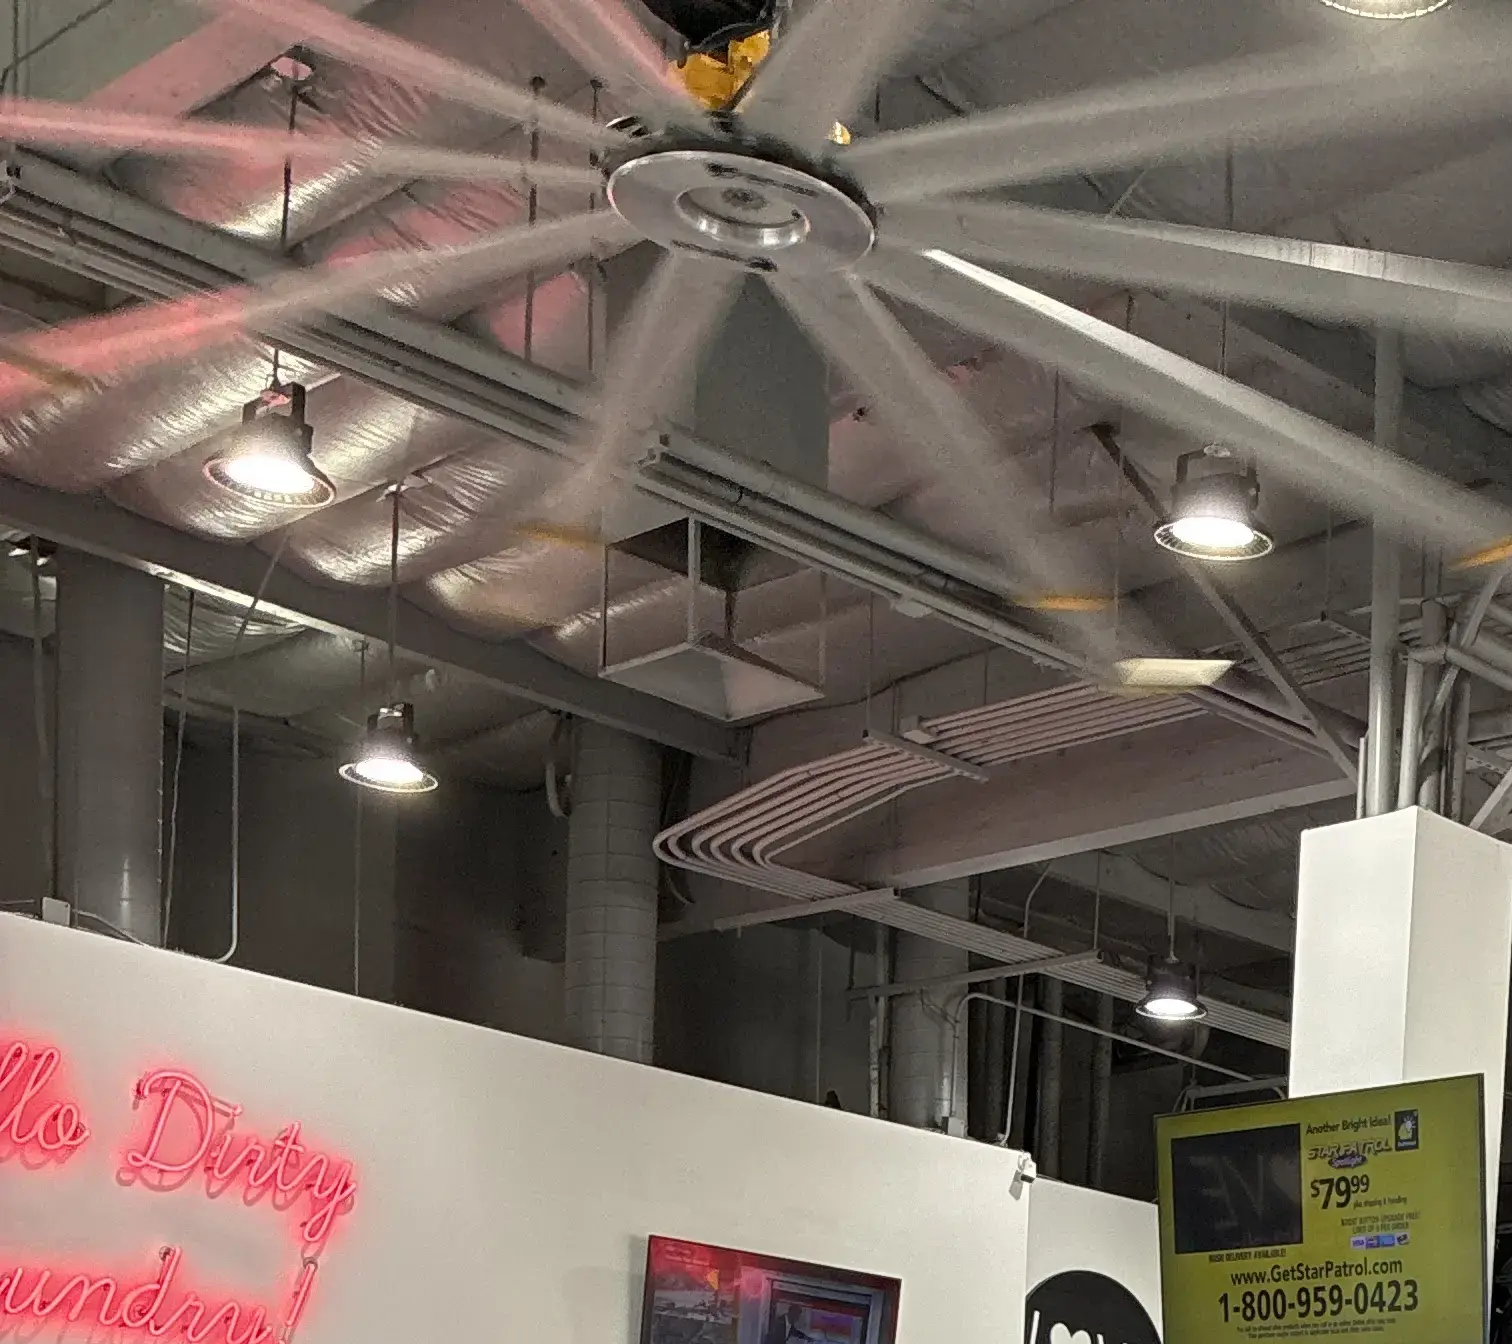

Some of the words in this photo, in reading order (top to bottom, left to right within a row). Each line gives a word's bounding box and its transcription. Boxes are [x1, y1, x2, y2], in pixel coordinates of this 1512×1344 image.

[1306, 1122, 1340, 1135] Another
[1342, 1117, 1368, 1132] Bright
[128, 1071, 356, 1242] Dirty
[1231, 1257, 1403, 1286] www.GetStarPatrol.com
[1219, 1279, 1418, 1323] 1-800-959-0423
